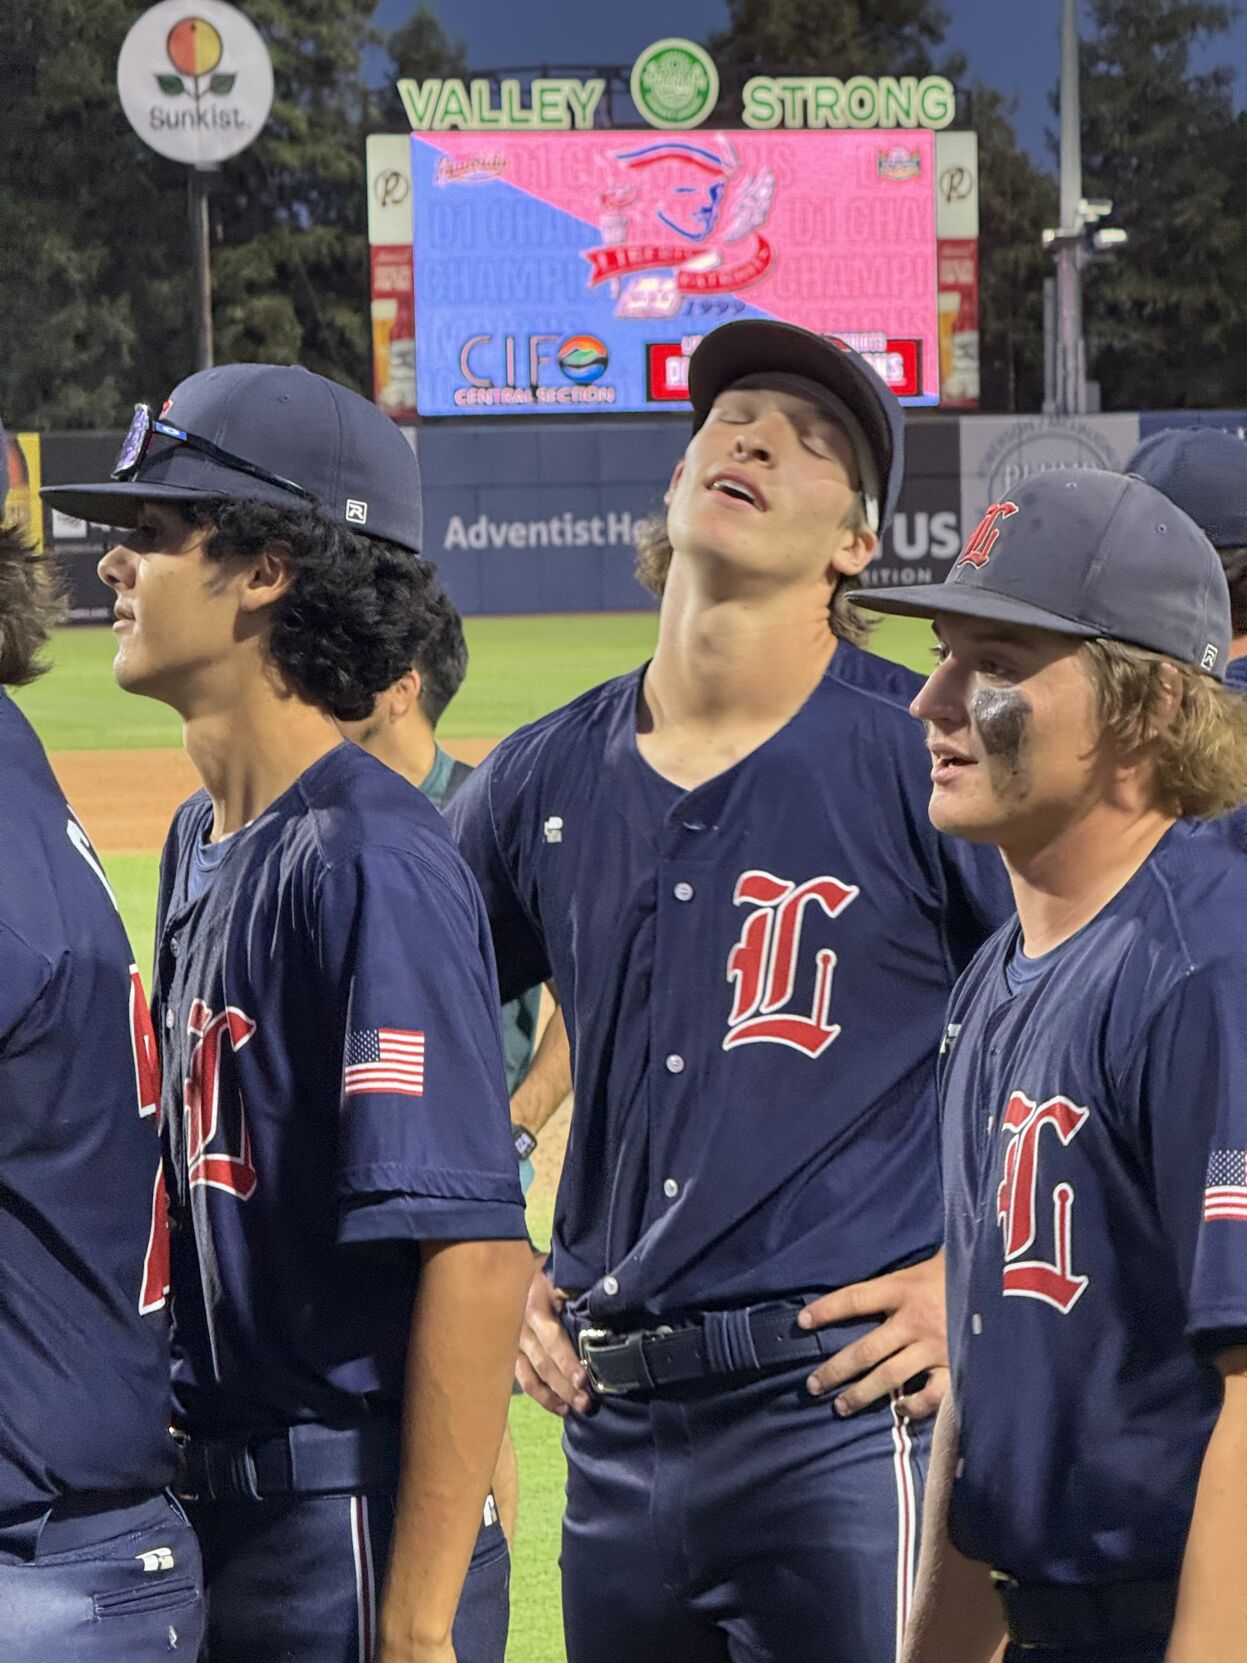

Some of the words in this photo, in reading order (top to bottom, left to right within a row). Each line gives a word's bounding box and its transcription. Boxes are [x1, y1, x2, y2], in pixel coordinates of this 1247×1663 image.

[397, 78, 605, 130] VALLEY
[742, 75, 955, 129] STRONG
[459, 335, 562, 388] CIF
[454, 388, 533, 406] CENTRAL
[535, 385, 615, 404] SECTION
[878, 511, 960, 560] US
